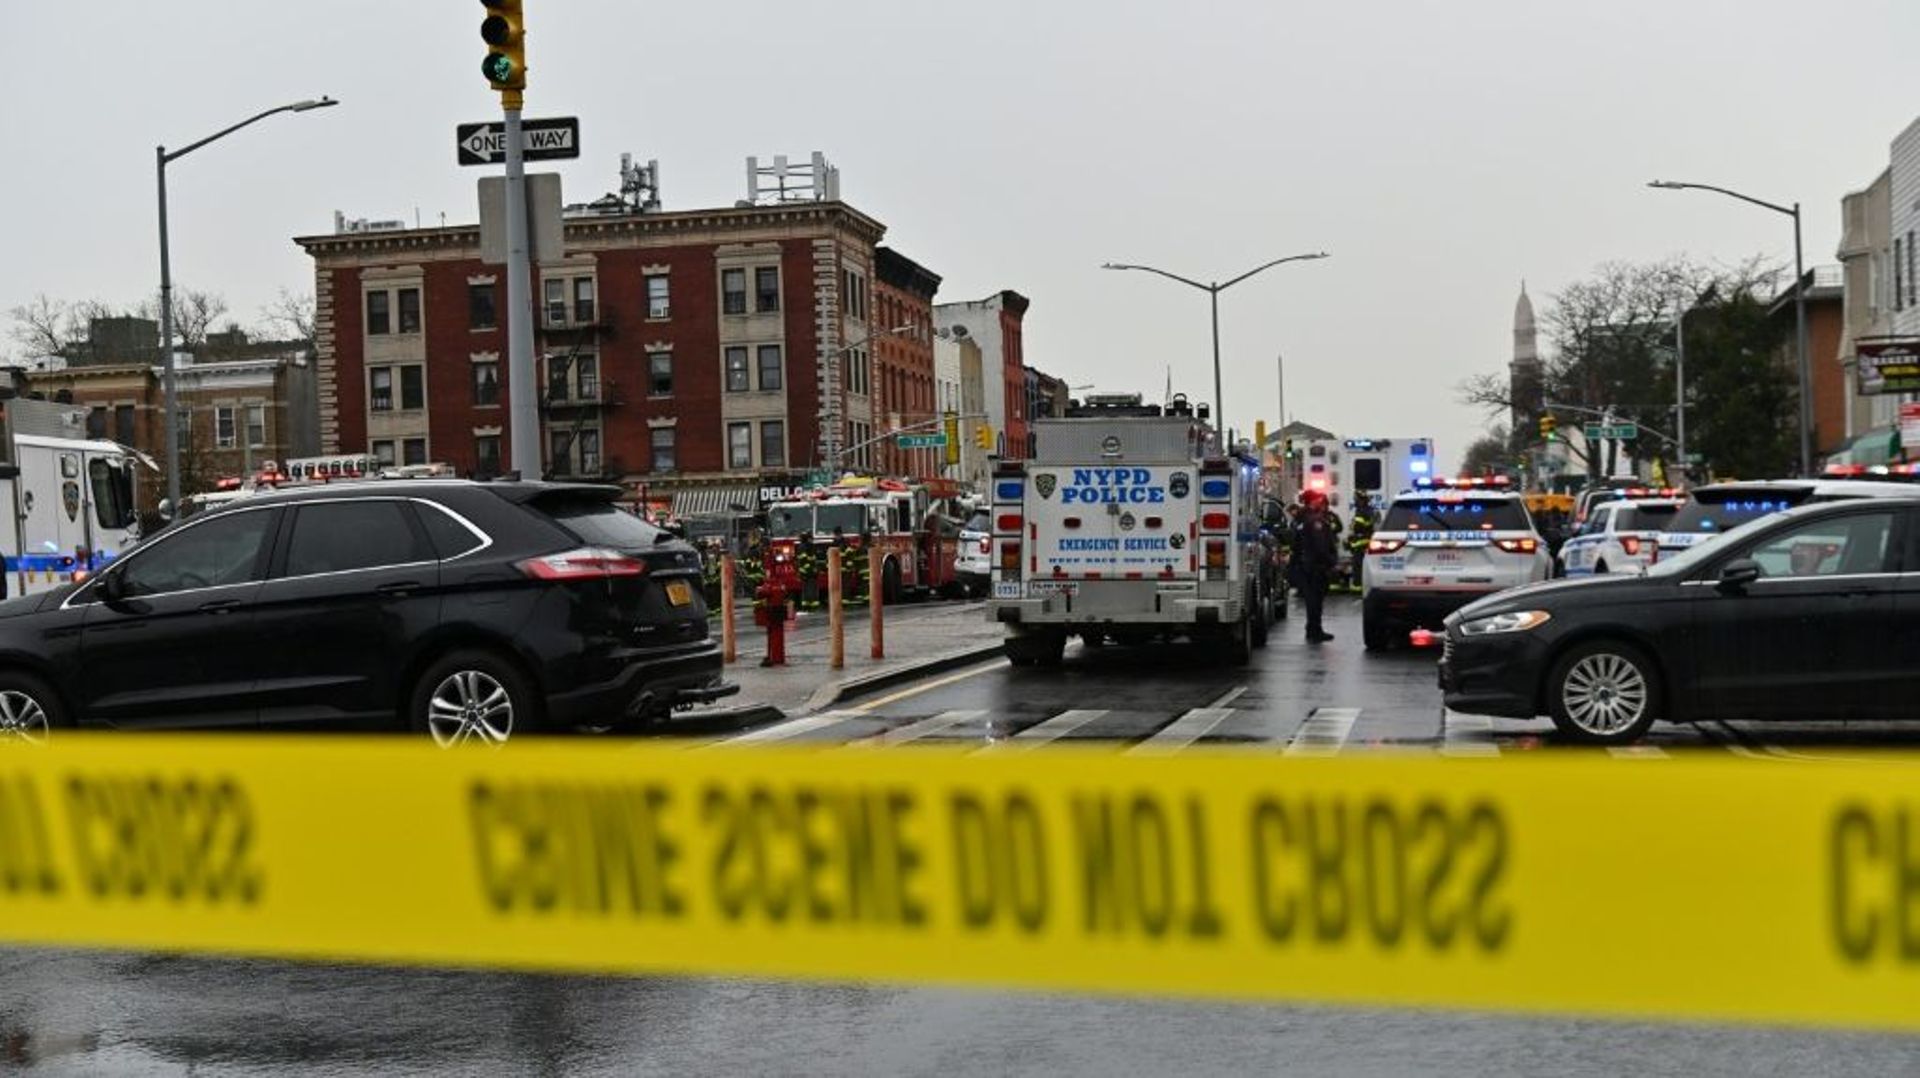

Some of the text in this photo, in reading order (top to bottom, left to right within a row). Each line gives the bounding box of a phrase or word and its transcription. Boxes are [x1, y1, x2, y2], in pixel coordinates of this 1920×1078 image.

[472, 131, 567, 152] ONE WAY
[1073, 468, 1151, 486] NYPD
[1061, 486, 1165, 504] POLICE
[1420, 504, 1482, 513] NYPD
[1407, 531, 1440, 541] NYPD
[1058, 537, 1168, 552] EMERGENCY SERVICE
